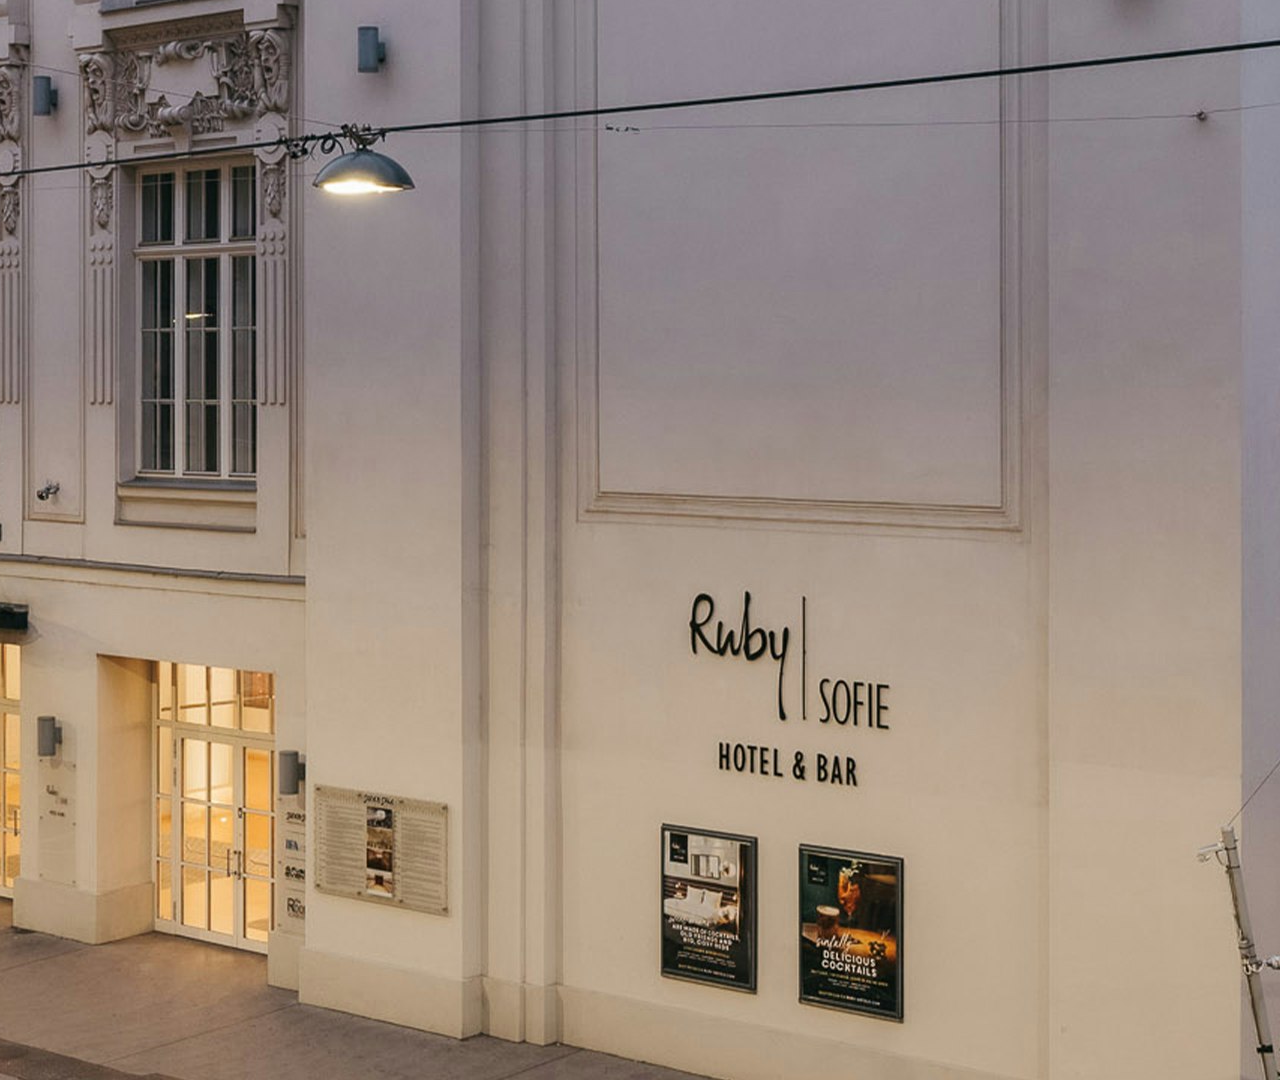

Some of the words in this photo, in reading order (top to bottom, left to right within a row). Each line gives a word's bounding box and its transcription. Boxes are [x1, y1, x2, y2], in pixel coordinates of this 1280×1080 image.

[689, 590, 789, 721] Ruby
[819, 677, 890, 730] SOFIE
[718, 742, 783, 778] HOTEL
[792, 751, 806, 781] &
[817, 753, 858, 788] BAR
[821, 959, 878, 978] COCKTAILS
[823, 949, 876, 968] DELICIOUS
